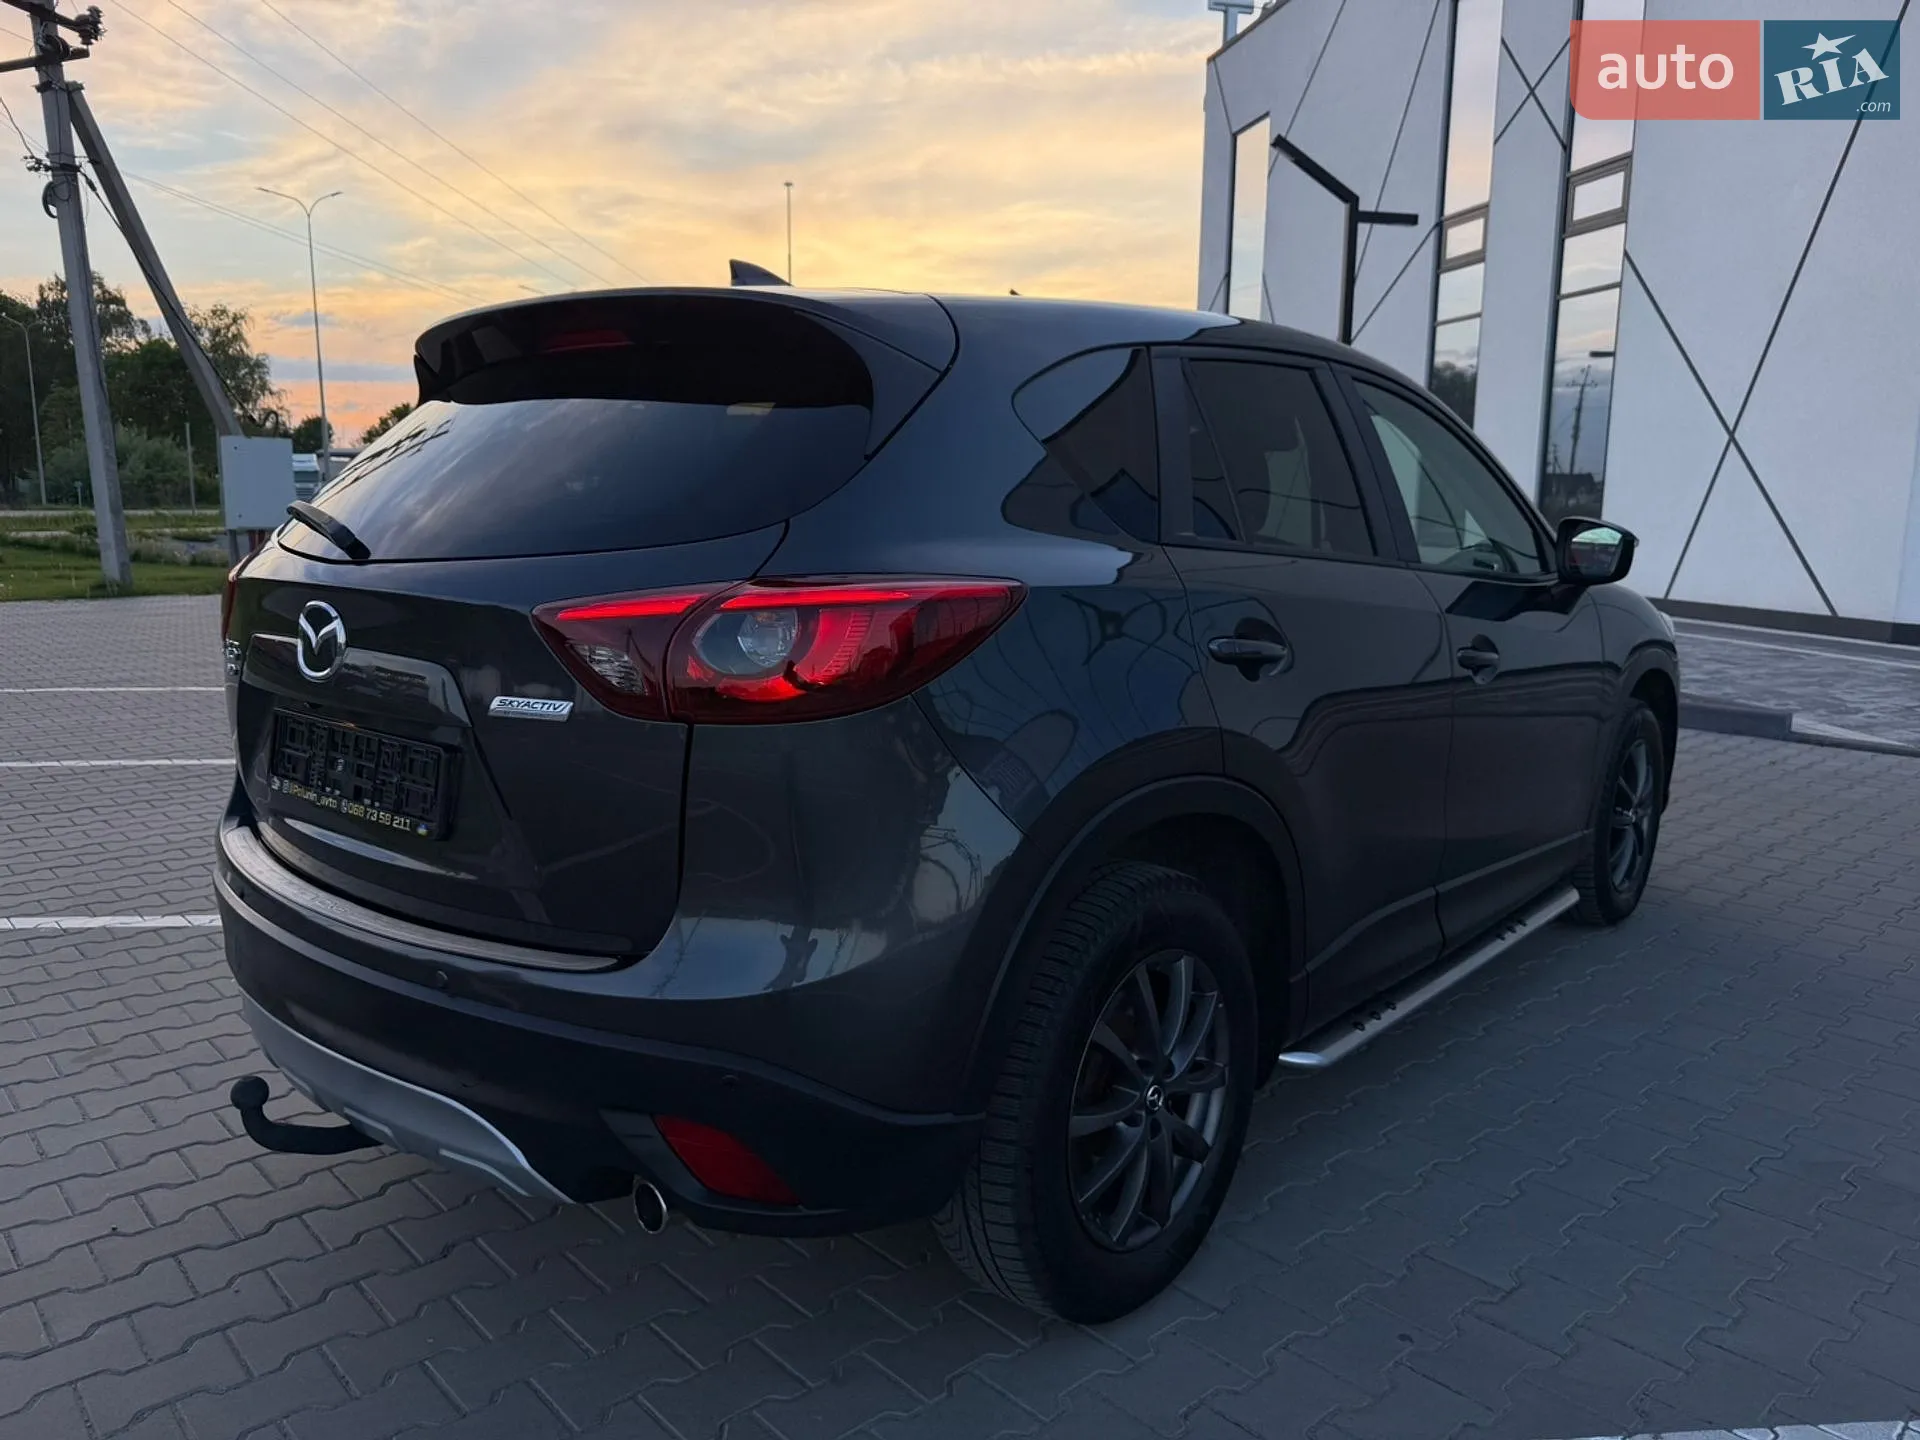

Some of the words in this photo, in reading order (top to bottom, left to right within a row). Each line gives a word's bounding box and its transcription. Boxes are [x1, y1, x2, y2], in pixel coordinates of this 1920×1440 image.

[496, 698, 567, 713] SKYACTIV
[348, 802, 365, 818] 068
[366, 807, 378, 821] 73
[392, 815, 411, 831] 211
